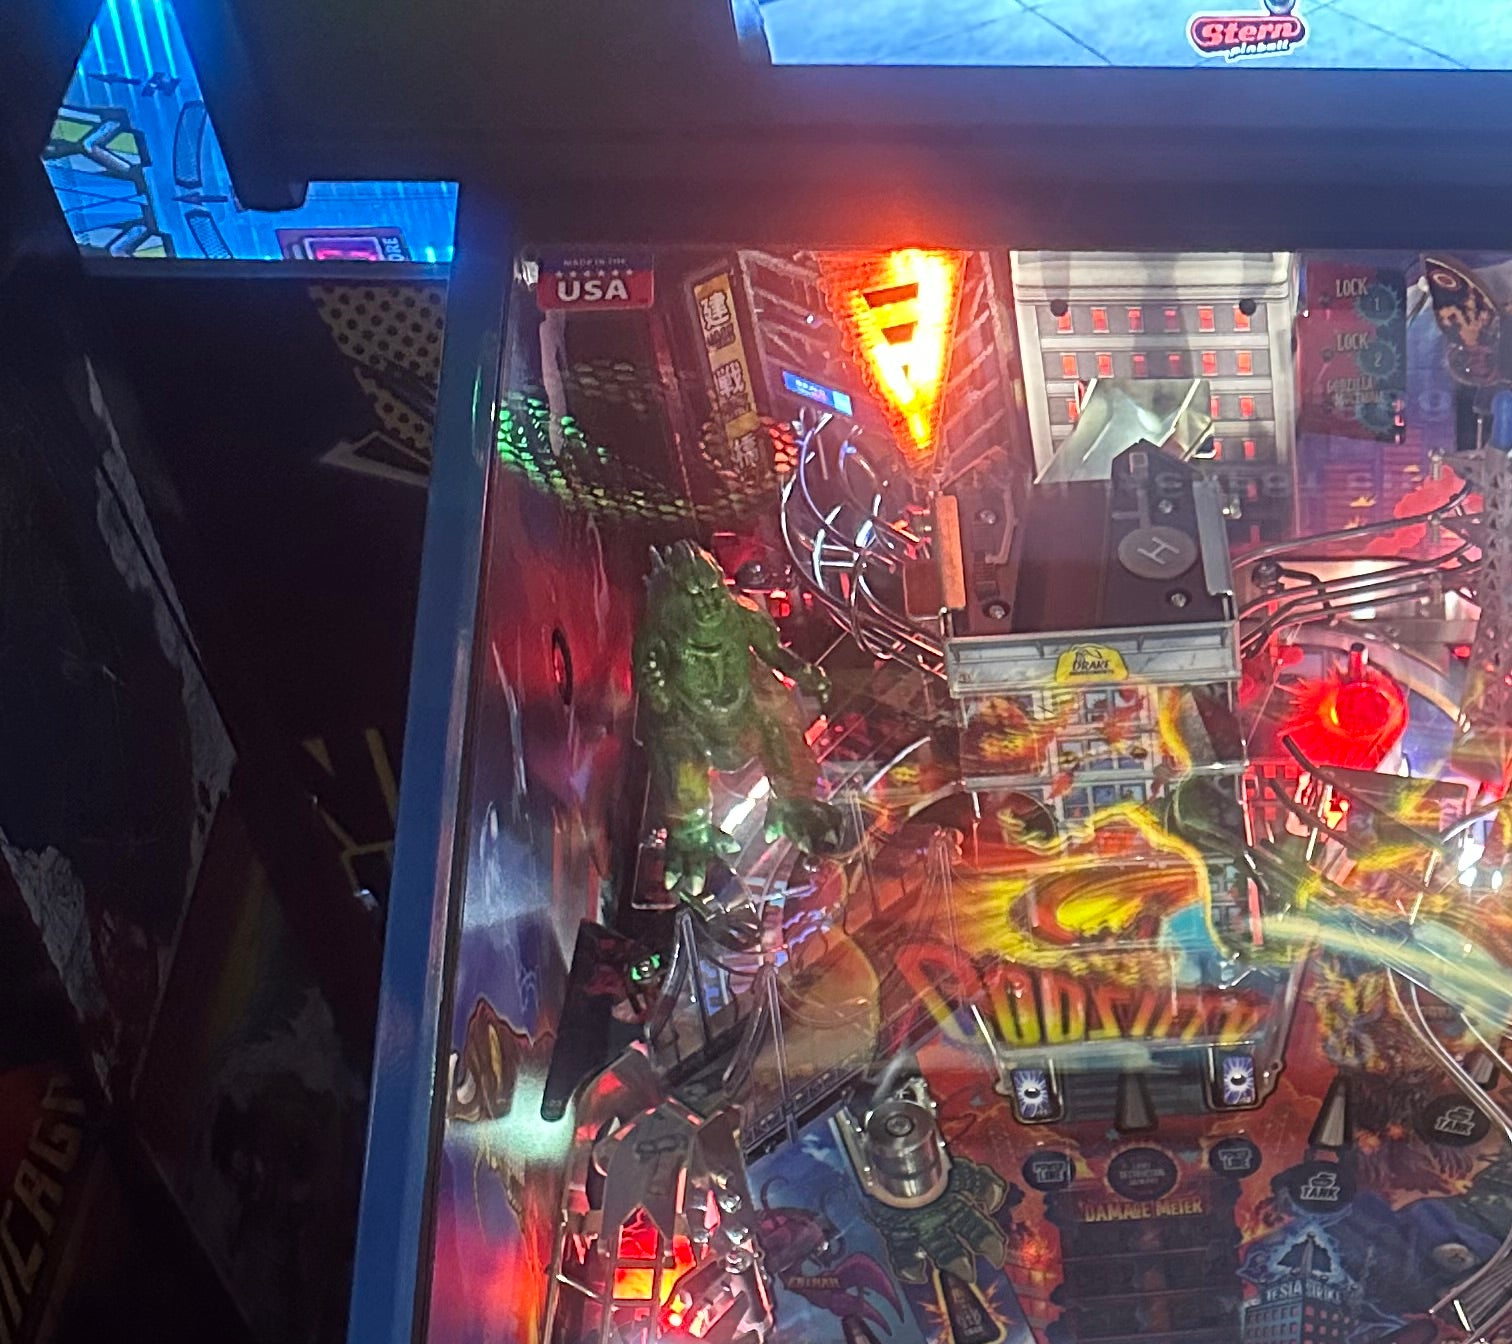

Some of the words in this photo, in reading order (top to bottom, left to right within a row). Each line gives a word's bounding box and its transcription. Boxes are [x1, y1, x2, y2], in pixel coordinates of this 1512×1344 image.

[1198, 19, 1300, 47] Stern
[1229, 39, 1290, 58] pinball
[557, 279, 629, 301] USA
[1335, 277, 1369, 298] LOCK
[1374, 297, 1381, 311] 1
[1336, 333, 1369, 351] LOCK
[1374, 354, 1382, 367] 2
[1434, 1116, 1476, 1137] TANK
[1301, 1184, 1340, 1201] TANK
